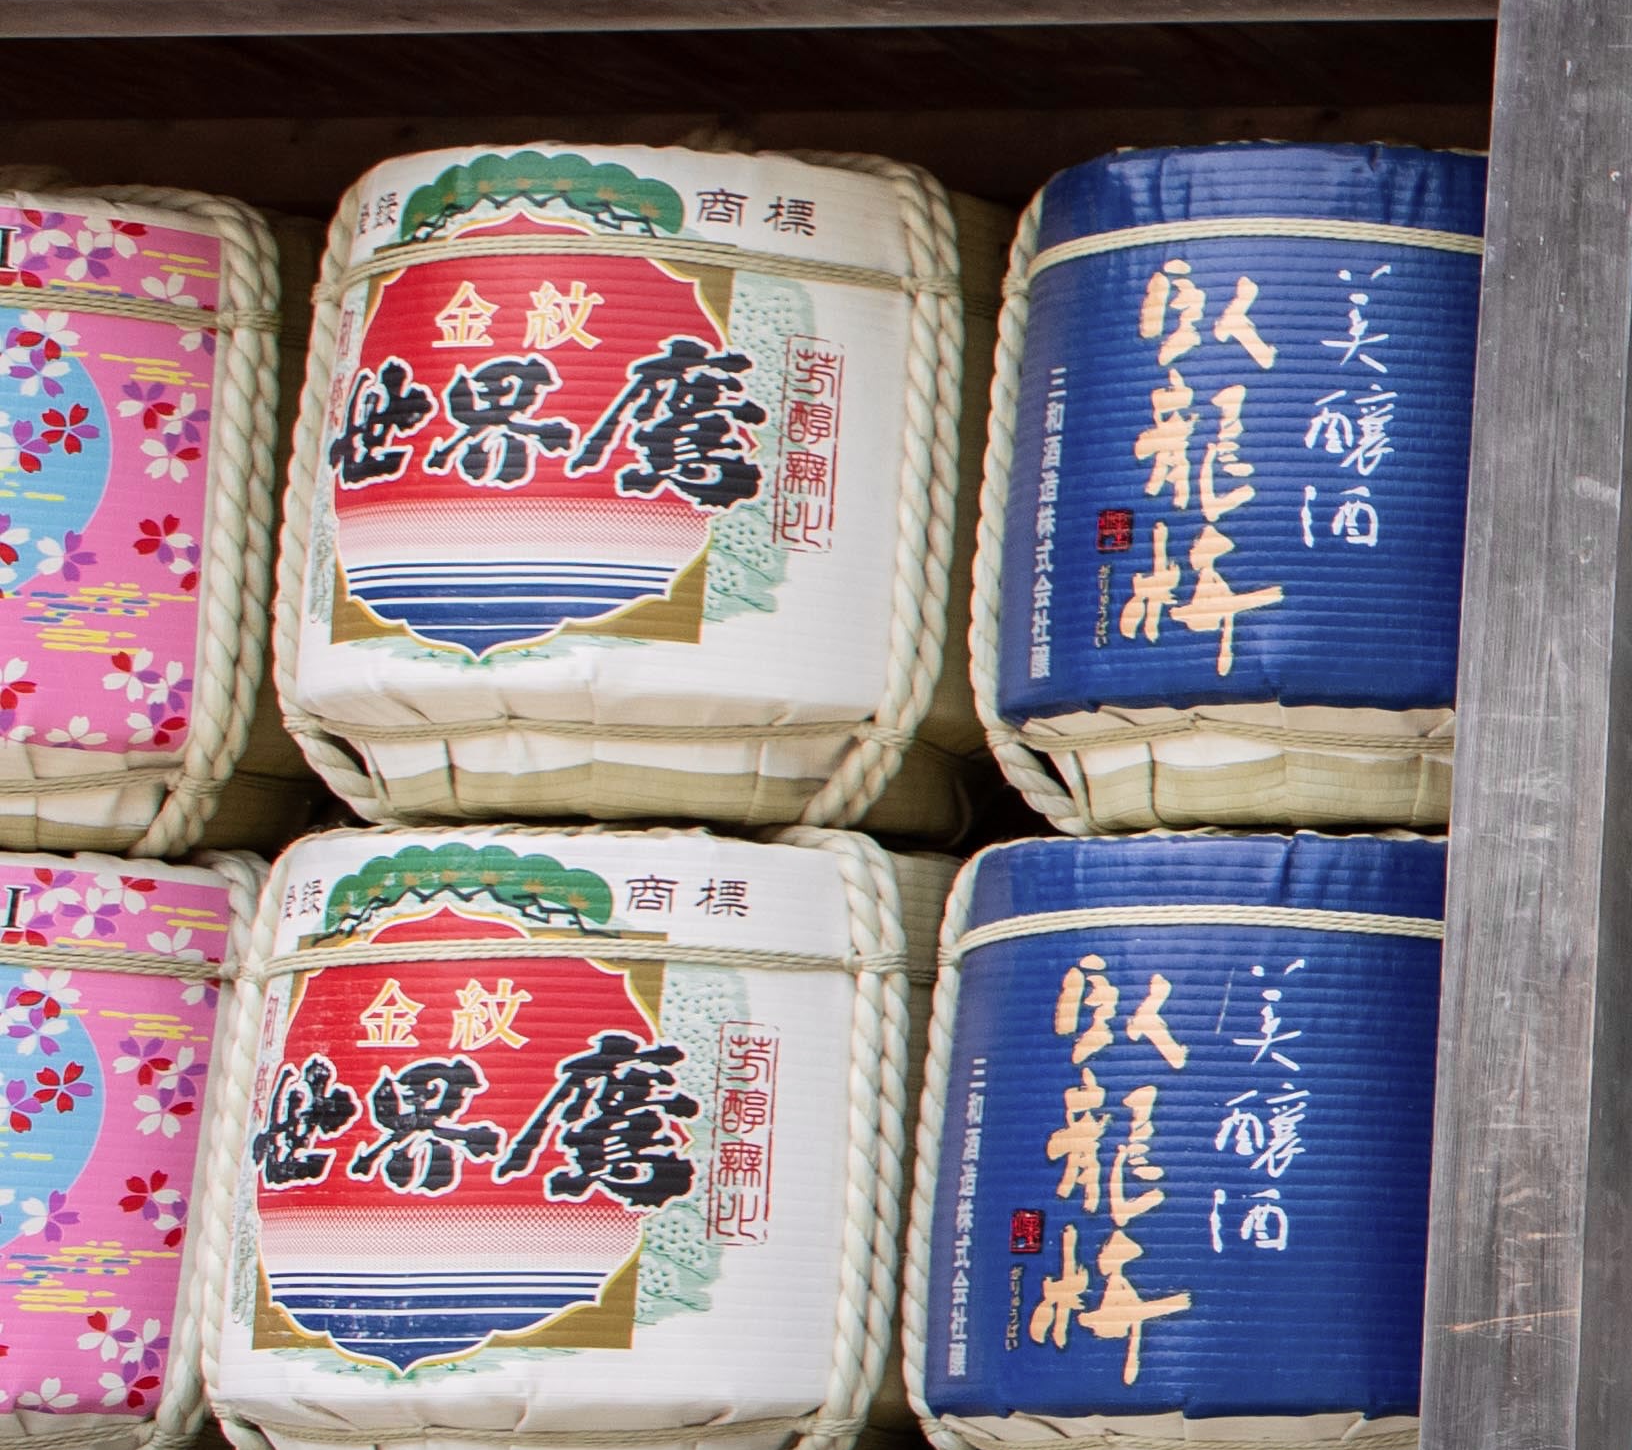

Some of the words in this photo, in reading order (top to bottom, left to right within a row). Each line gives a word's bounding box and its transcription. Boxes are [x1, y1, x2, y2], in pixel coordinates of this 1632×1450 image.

[695, 188, 816, 238] 商標
[432, 281, 604, 350] 金紋
[625, 875, 751, 918] 商標
[356, 978, 534, 1051] 金紋
